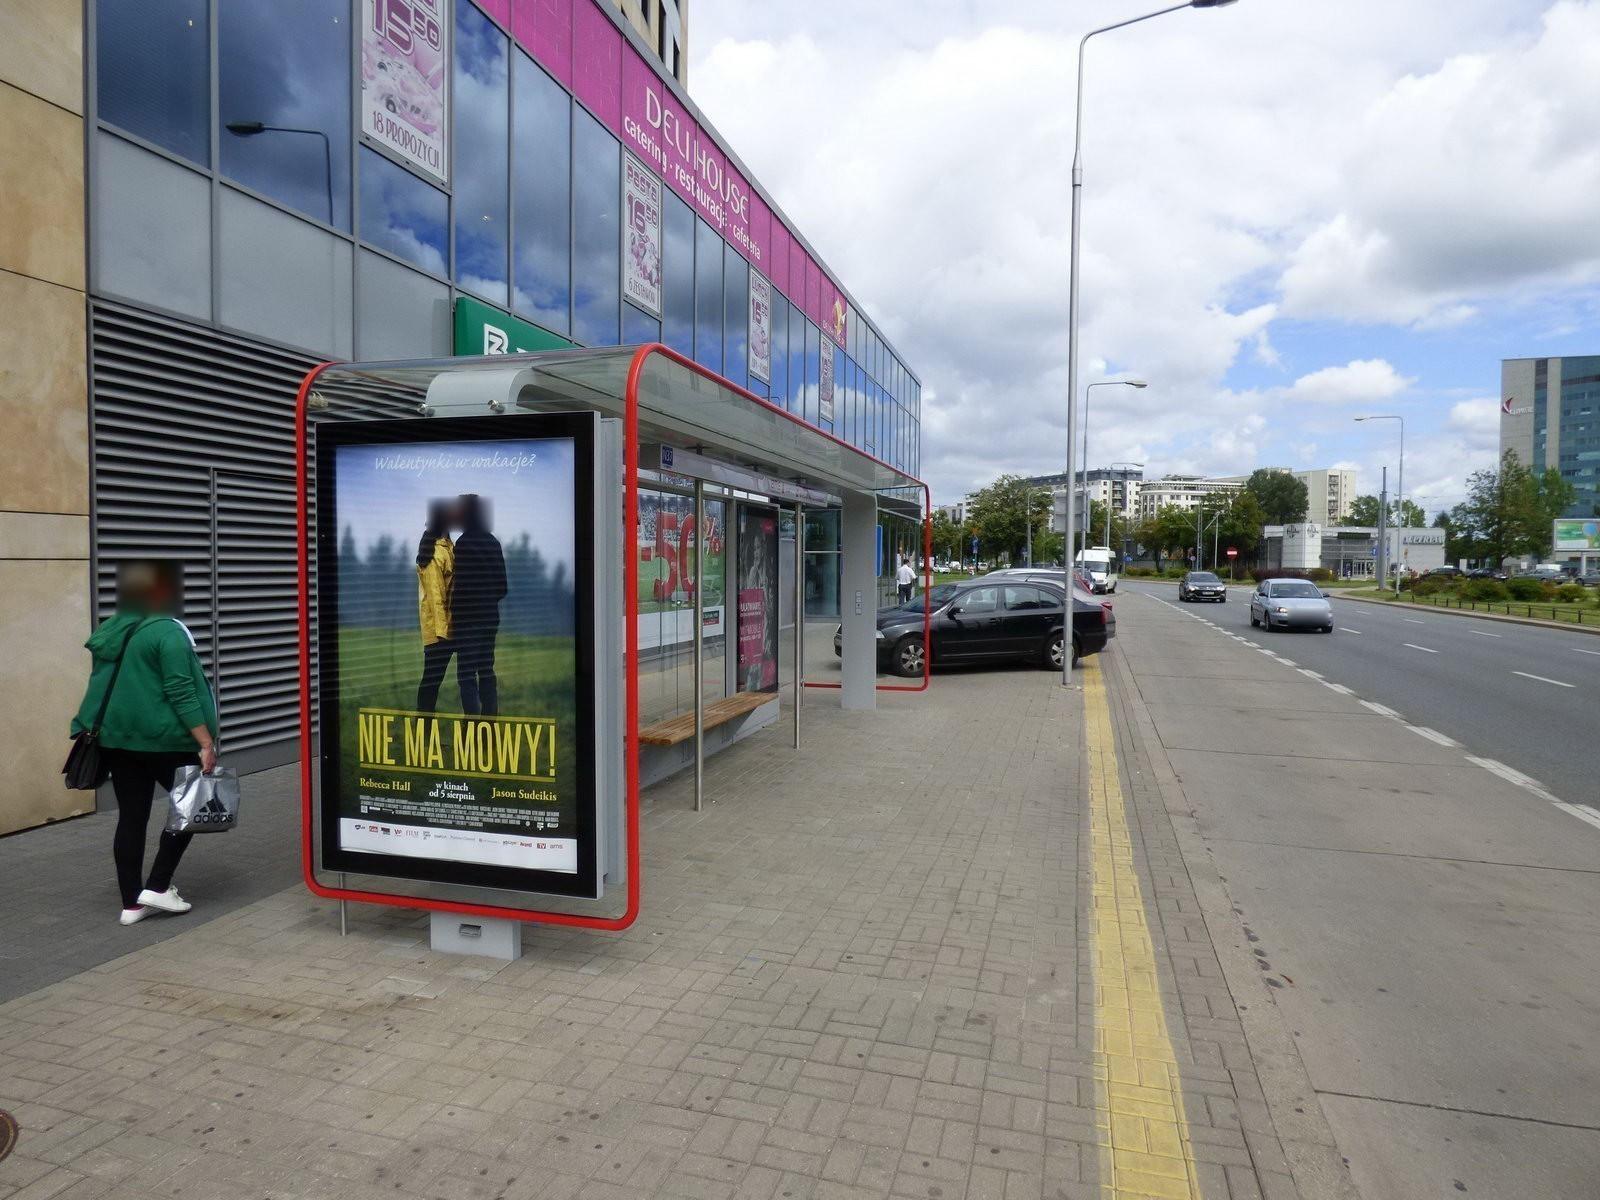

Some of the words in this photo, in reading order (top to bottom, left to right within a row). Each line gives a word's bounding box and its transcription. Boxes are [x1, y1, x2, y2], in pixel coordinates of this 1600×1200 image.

[372, 110, 385, 135] 18
[385, 118, 440, 170] PROPOZYCJI
[624, 115, 667, 174] catering
[646, 86, 690, 163] DELI
[693, 139, 749, 225] HOUSE
[375, 453, 451, 480] Walentynki
[455, 457, 471, 469] w
[471, 451, 537, 475] wakacje?
[359, 714, 396, 765] NIE
[404, 717, 444, 769] MA
[359, 777, 390, 790] Rebecca
[392, 780, 411, 792] Hall
[429, 789, 439, 797] od
[440, 790, 446, 799] 5
[446, 791, 476, 802] sierpnia
[443, 781, 469, 792] kinach
[491, 787, 517, 799] Jason
[518, 789, 557, 801] Sudeikis
[193, 812, 234, 825] adidas
